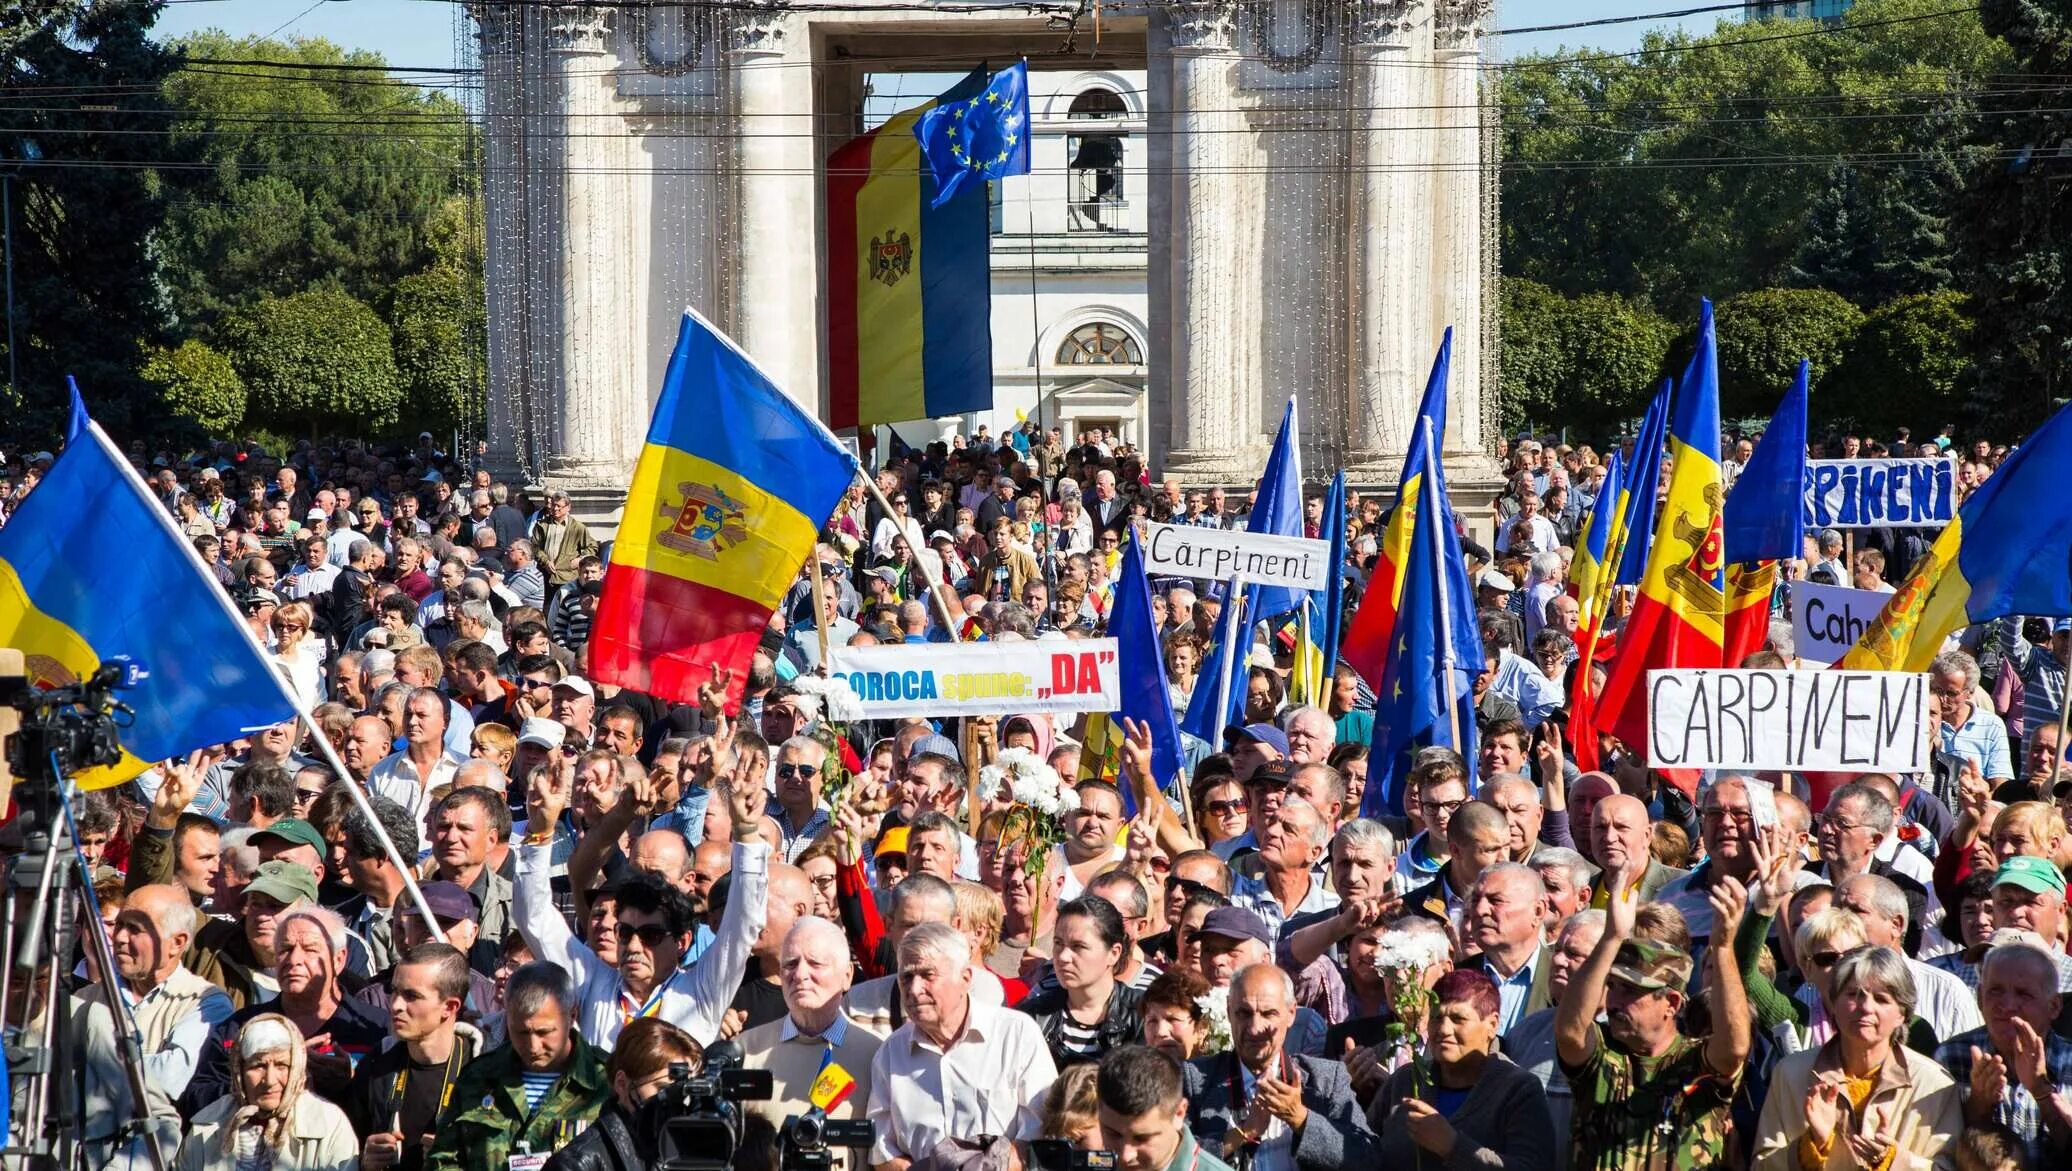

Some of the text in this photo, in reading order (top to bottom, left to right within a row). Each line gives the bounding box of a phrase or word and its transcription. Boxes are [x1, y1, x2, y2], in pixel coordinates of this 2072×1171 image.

[1152, 527, 1312, 580] Cărpineni
[1806, 598, 1873, 646] Cah
[832, 670, 937, 701] OROCA
[942, 672, 1033, 701] spune:
